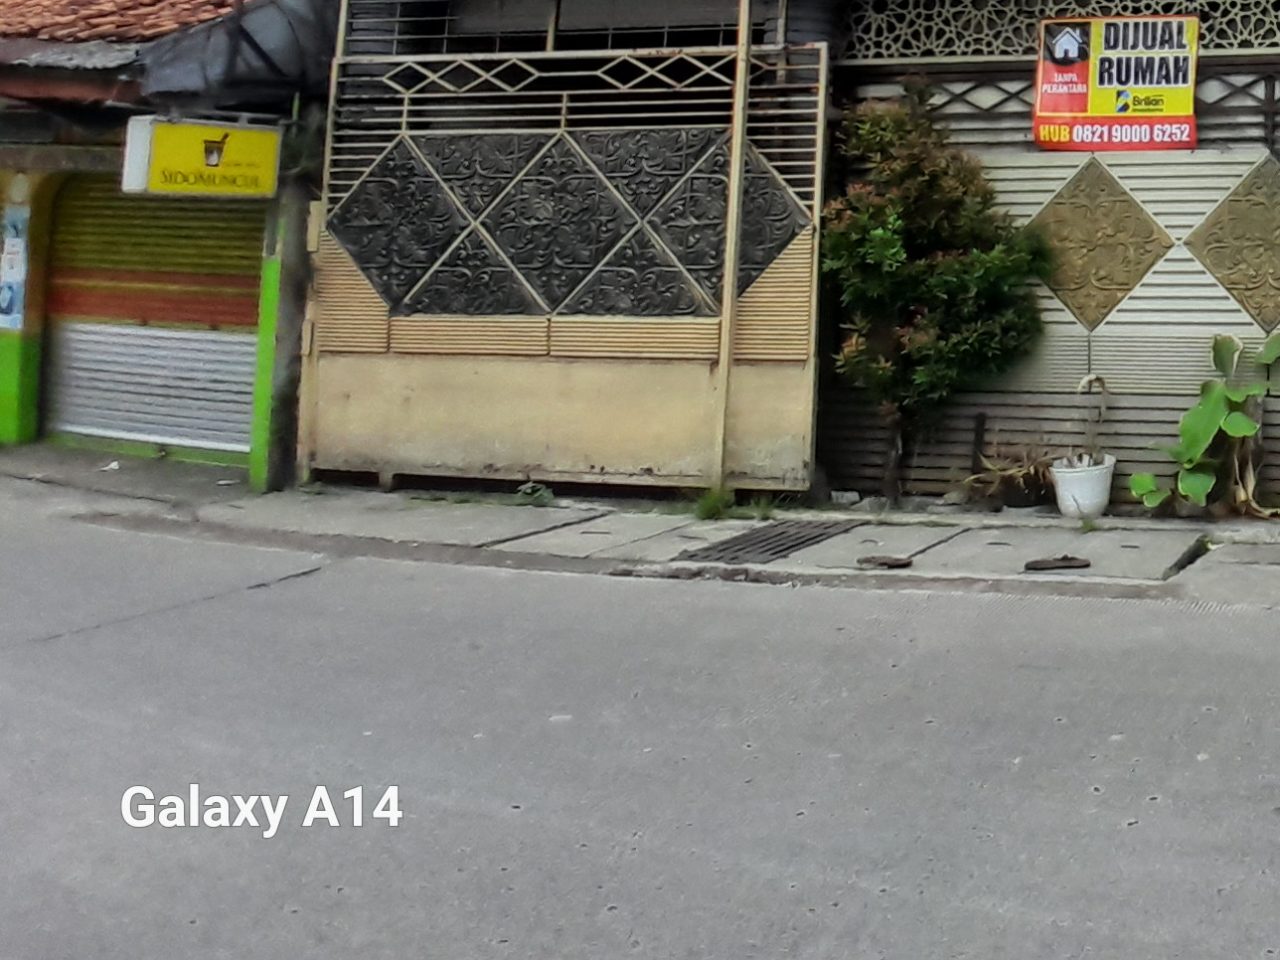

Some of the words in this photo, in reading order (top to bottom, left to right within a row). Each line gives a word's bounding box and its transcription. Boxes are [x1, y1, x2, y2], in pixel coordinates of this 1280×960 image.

[1104, 21, 1187, 51] DIJUAL
[1098, 56, 1190, 87] RUMAH
[1039, 124, 1069, 143] HUB
[1072, 123, 1109, 142] 0821
[1111, 123, 1150, 142] 9000
[1152, 123, 1190, 142] 6252
